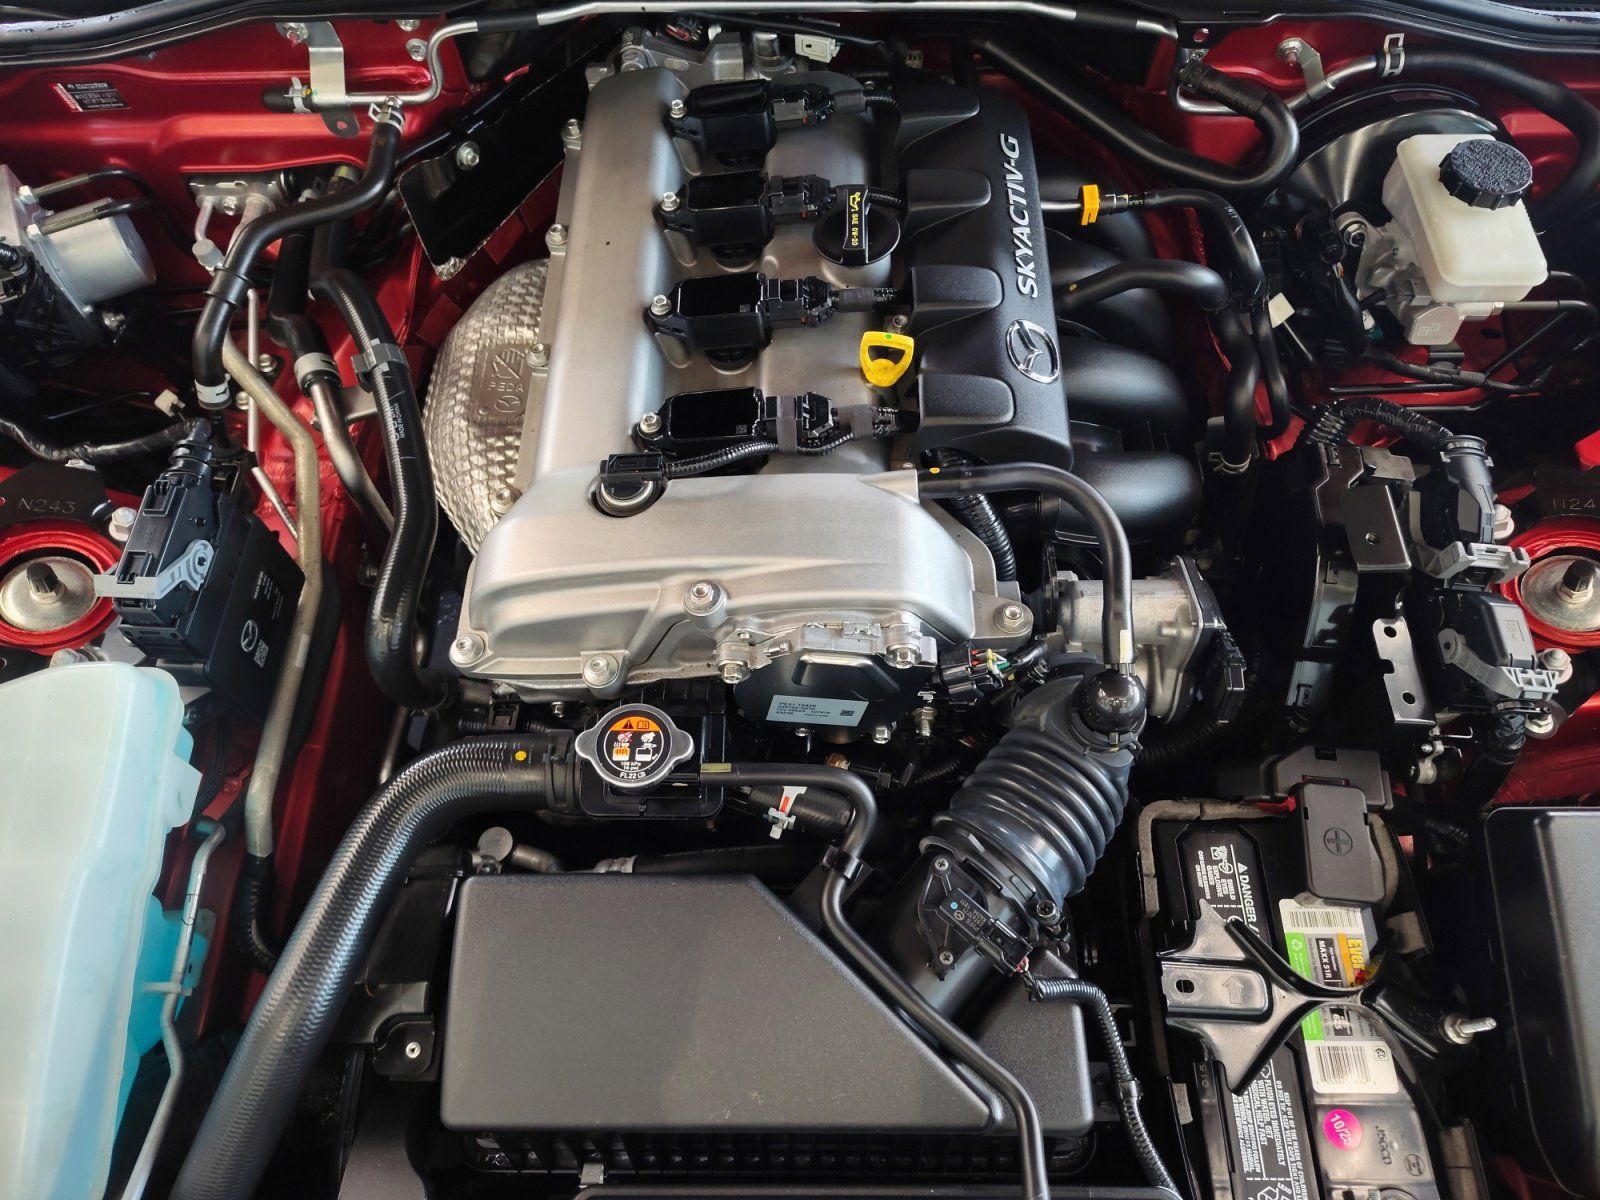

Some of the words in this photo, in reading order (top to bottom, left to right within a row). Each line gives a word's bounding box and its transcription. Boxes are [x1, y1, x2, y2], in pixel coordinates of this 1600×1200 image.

[1000, 133, 1038, 299] SKYACTIV-G
[17, 497, 75, 513] N243
[1240, 875, 1256, 922] DANGER
[1319, 941, 1328, 962] MAXX
[1333, 1014, 1342, 1029] 625
[1265, 1080, 1274, 1101] FLUSH
[1255, 1110, 1264, 1127] HELP
[1258, 1080, 1266, 1097] WITH
[1265, 1125, 1273, 1138] GET
[1268, 1102, 1277, 1119] EYES
[1259, 1129, 1267, 1145] FAST
[1272, 1120, 1285, 1165] IMMEDIATELY
